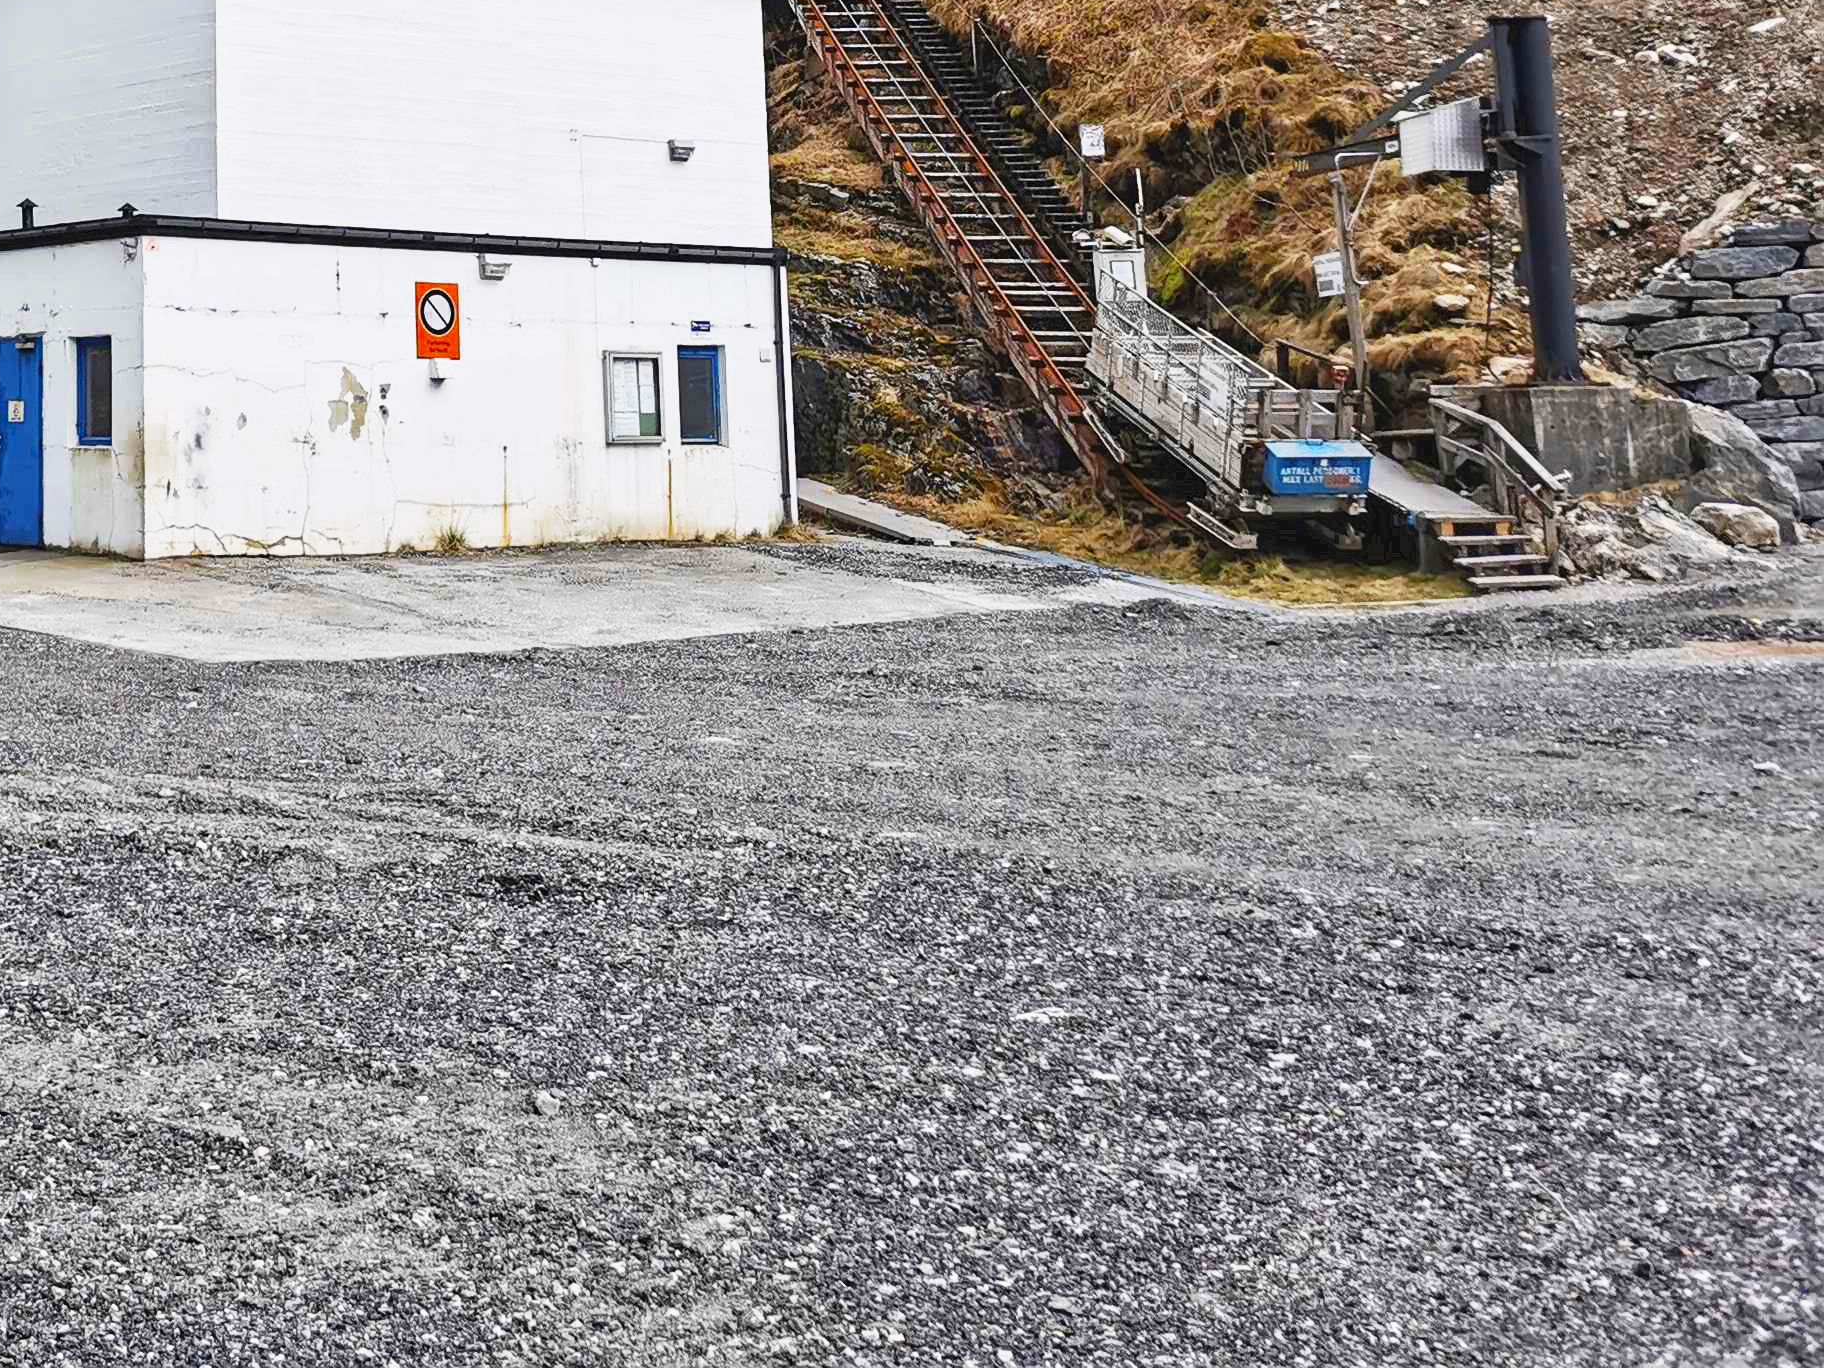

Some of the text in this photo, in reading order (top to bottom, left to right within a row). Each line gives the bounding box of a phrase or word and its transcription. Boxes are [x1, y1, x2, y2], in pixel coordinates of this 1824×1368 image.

[1280, 466, 1311, 475] ANTALL
[1282, 475, 1301, 484] MAX
[1303, 475, 1324, 484] LAST
